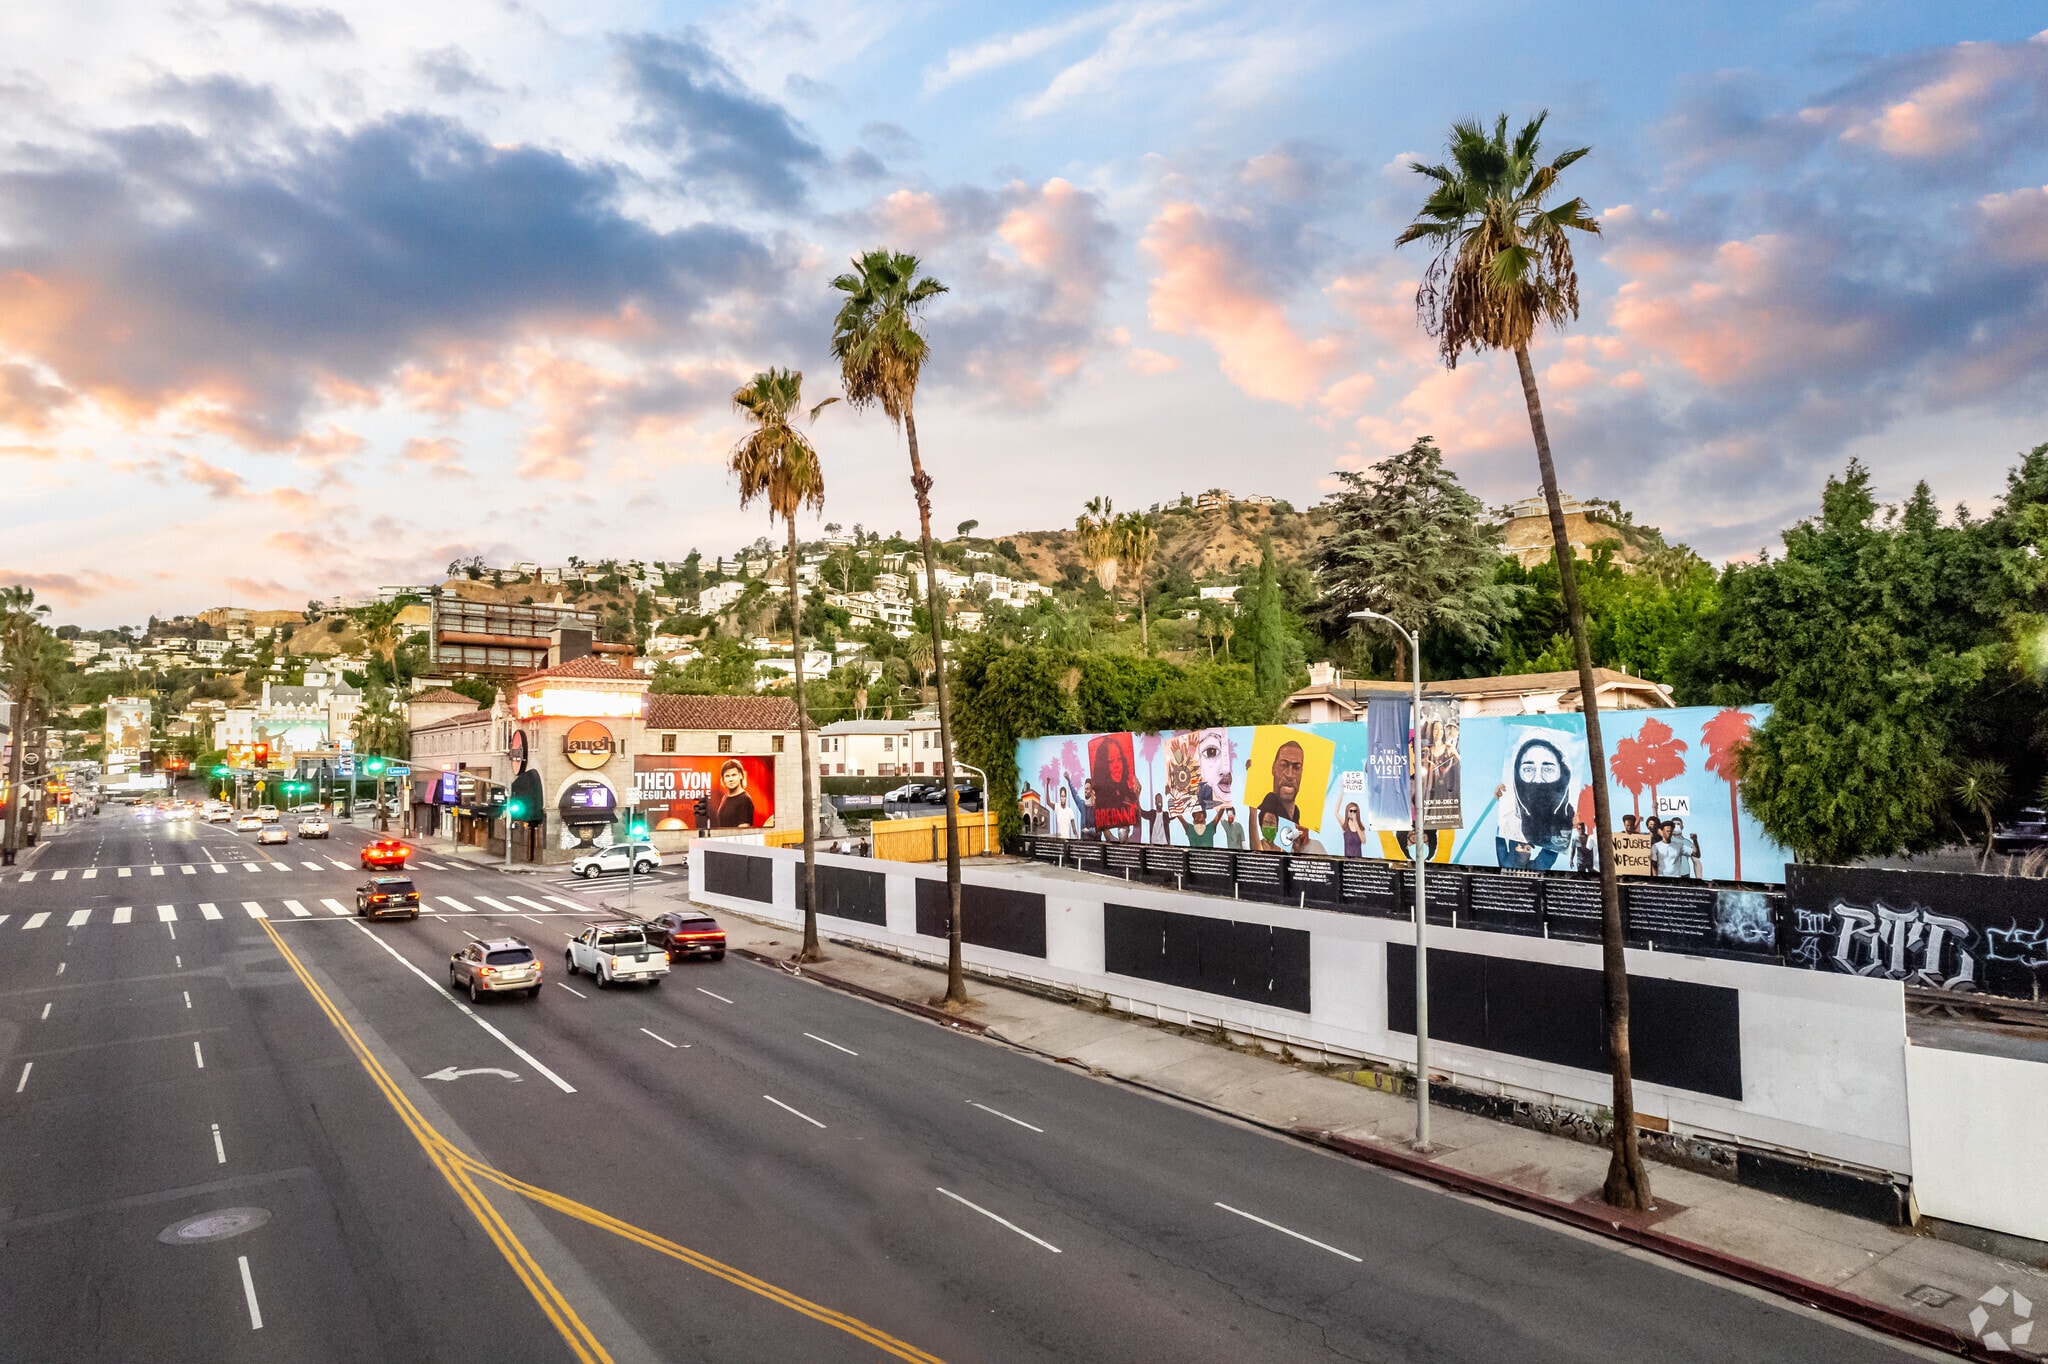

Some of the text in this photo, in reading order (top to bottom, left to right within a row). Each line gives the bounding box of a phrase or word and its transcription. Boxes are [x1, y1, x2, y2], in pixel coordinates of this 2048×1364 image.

[561, 734, 617, 755] Laugh
[1374, 765, 1404, 776] VISIT
[634, 772, 712, 790] THEO VON
[1659, 797, 1688, 812] BLM
[1622, 838, 1651, 850] JUSTICE
[1622, 855, 1650, 867] PEACE
